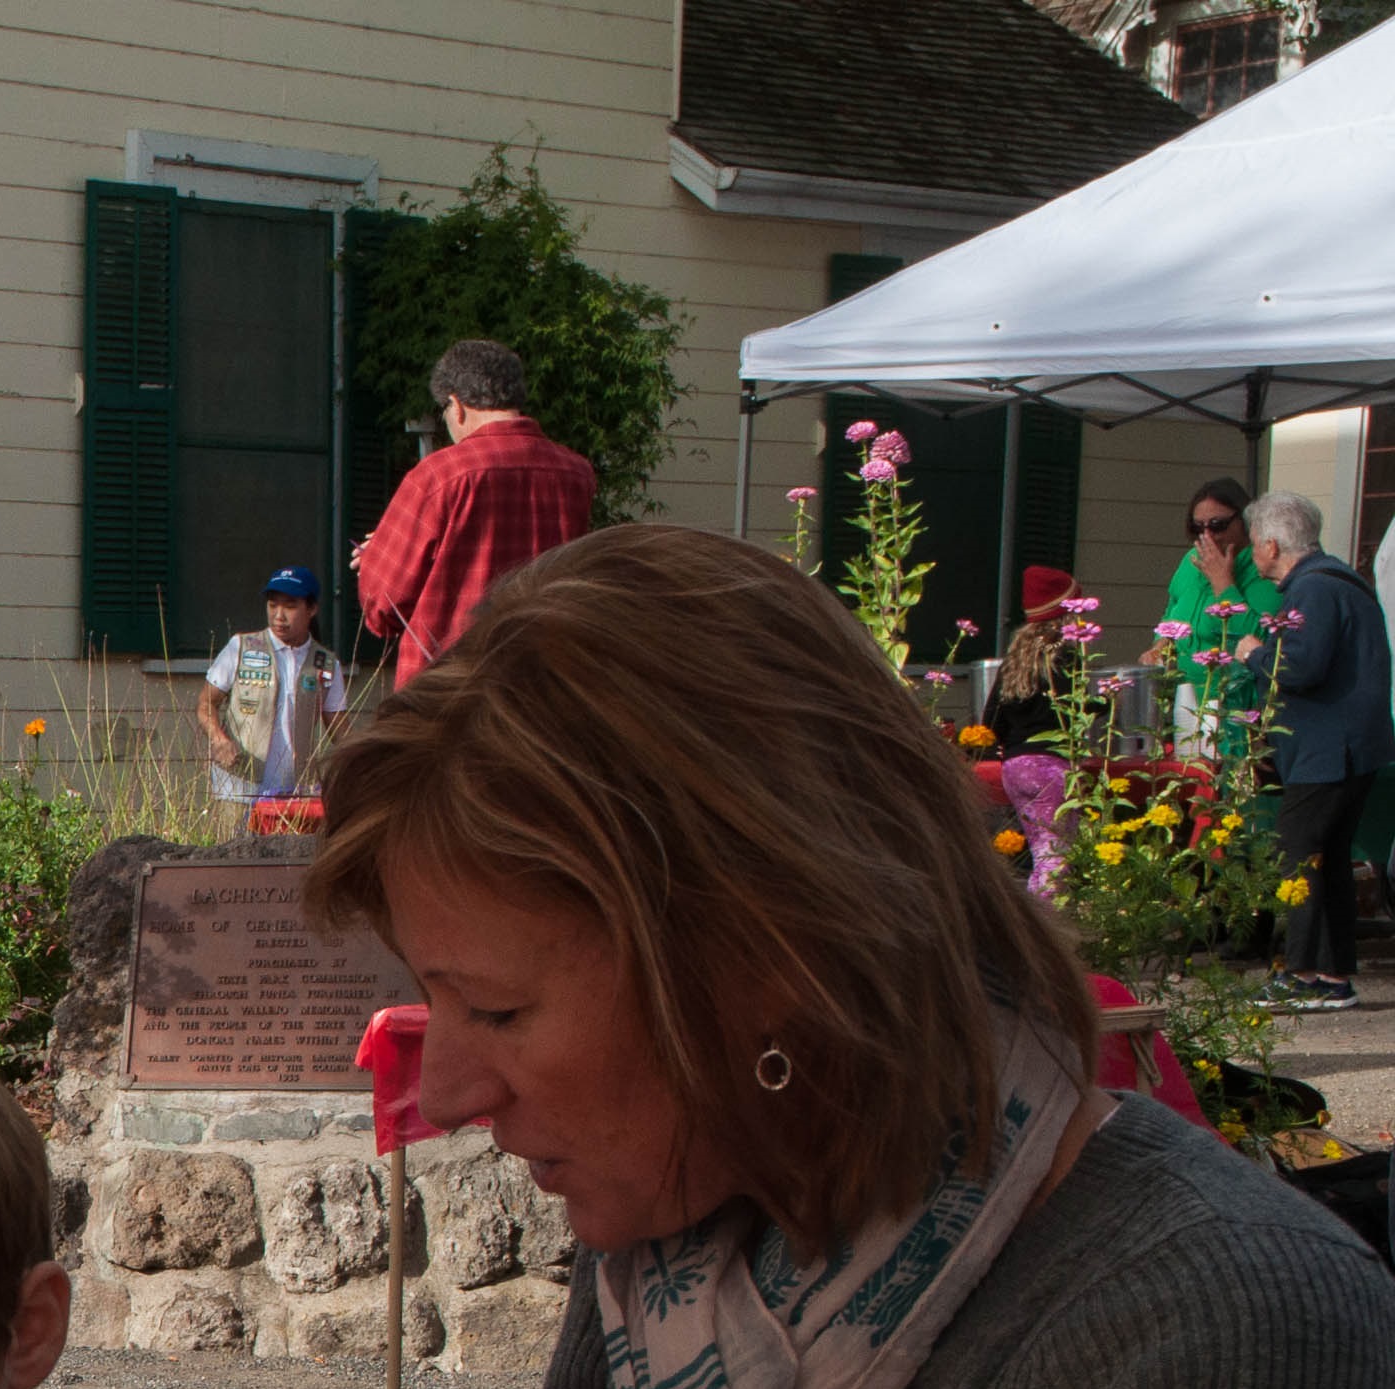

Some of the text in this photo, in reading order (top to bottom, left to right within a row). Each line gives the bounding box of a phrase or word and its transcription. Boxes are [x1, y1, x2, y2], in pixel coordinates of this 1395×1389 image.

[148, 919, 307, 933] HOME OF GENERA
[144, 1005, 167, 1017] THE
[175, 1005, 230, 1017] GENERAL
[142, 1021, 171, 1031] AND
[178, 1020, 201, 1031] THE
[258, 1020, 273, 1031] OF
[281, 1020, 304, 1031] THE
